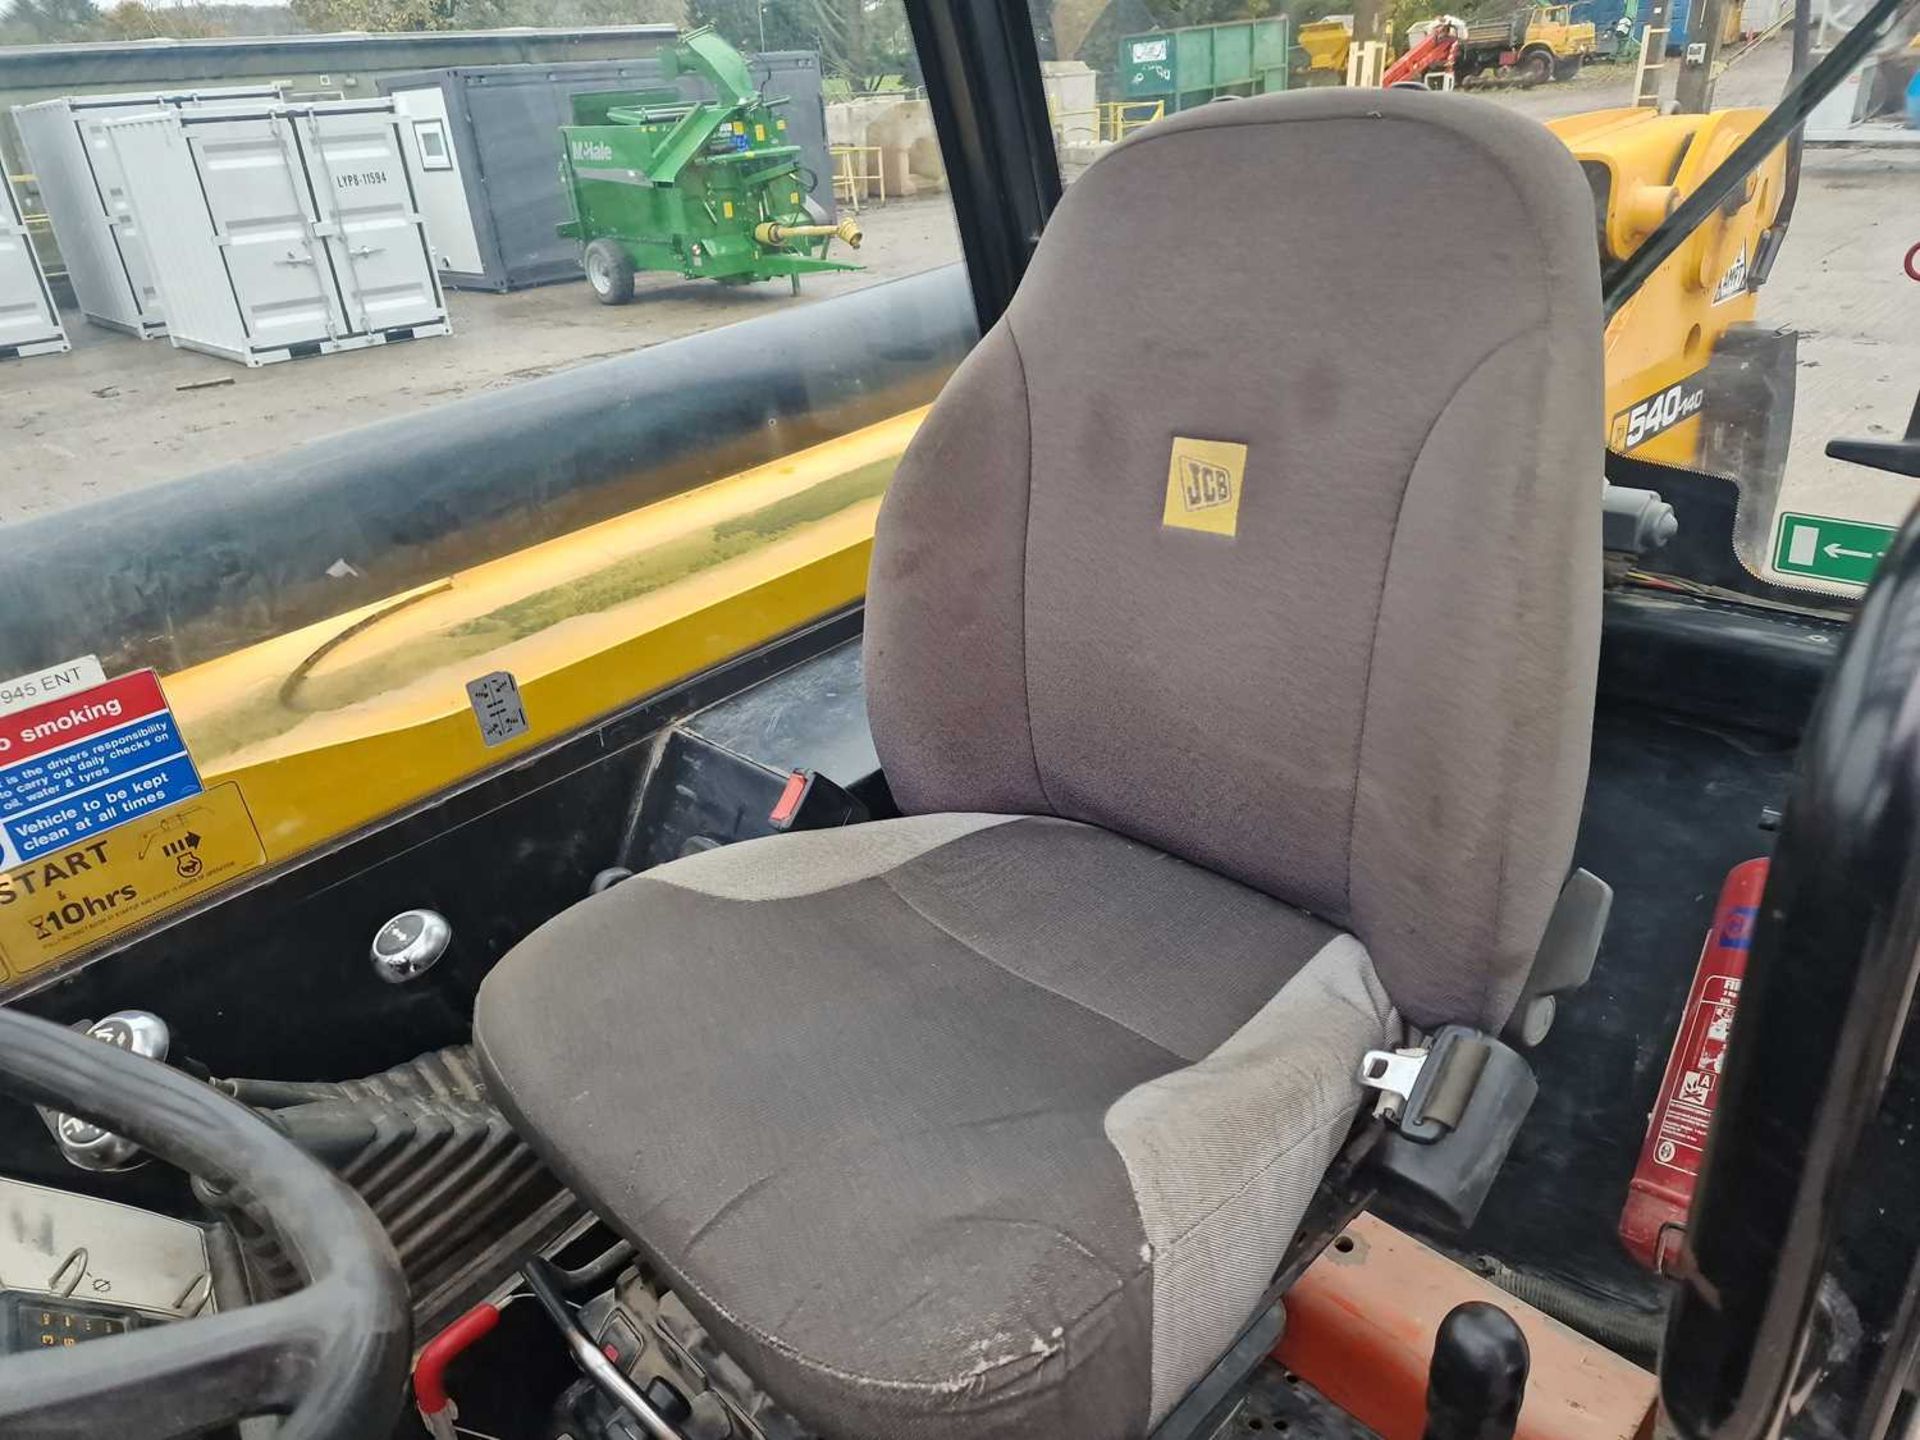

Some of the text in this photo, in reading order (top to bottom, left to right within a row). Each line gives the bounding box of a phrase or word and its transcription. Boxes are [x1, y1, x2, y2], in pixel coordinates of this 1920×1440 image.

[1188, 462, 1228, 506] JCB
[41, 667, 81, 691] ENT
[0, 699, 122, 751] o smoking
[22, 767, 43, 779] the
[46, 750, 89, 770] drivers
[92, 722, 167, 754] responsibility
[16, 776, 48, 793] carry
[53, 766, 74, 779] out
[77, 755, 105, 771] daily
[109, 739, 151, 759] checks
[154, 733, 169, 743] on
[26, 785, 60, 802] water
[65, 778, 74, 788] &
[78, 766, 110, 782] tyres
[15, 772, 169, 837] Vehicle to be kept
[23, 790, 166, 851] clean at all times
[0, 840, 108, 905] START
[46, 884, 138, 931] 10hrs
[1700, 1074, 1711, 1088] A
